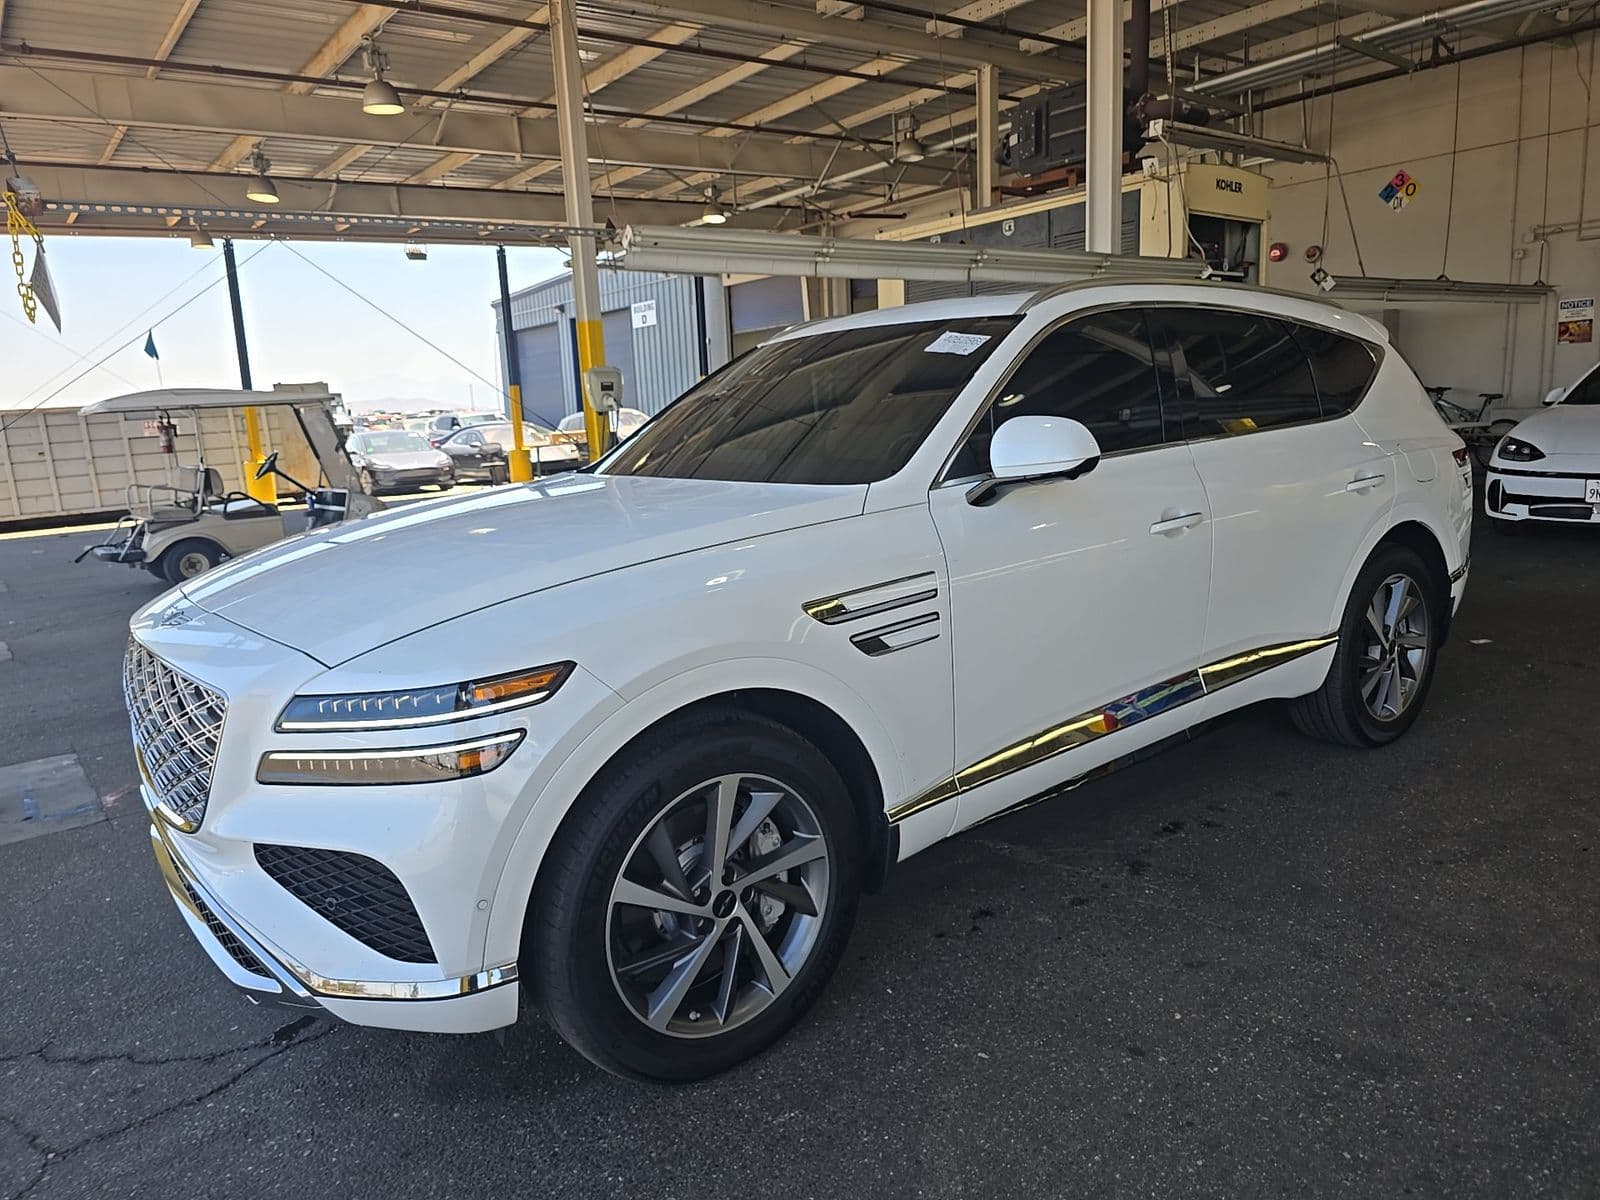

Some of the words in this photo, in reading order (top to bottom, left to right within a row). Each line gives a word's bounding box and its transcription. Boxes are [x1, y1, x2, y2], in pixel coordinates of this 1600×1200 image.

[1215, 178, 1243, 194] KOHLER
[1560, 300, 1591, 309] NOTICE
[641, 314, 648, 325] D
